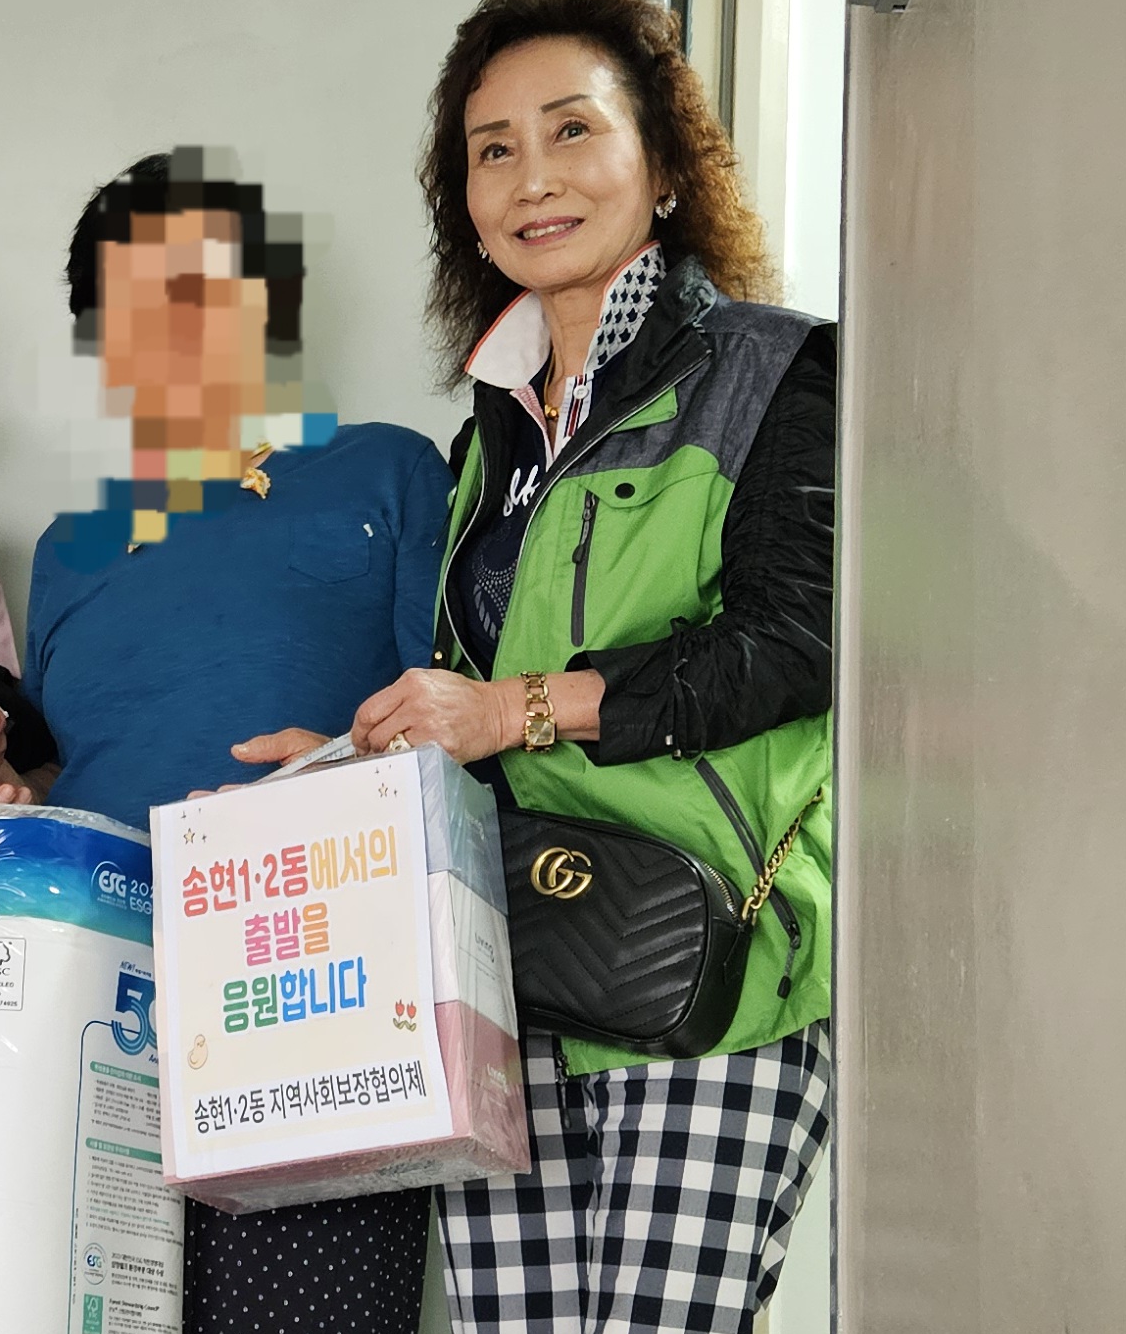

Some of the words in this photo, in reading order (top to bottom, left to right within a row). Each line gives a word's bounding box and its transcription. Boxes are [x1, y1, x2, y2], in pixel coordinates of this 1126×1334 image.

[98, 870, 127, 898] ESG
[183, 826, 398, 918] 송현1·2동에서의
[244, 901, 330, 967] 출발을
[223, 955, 367, 1033] 응원합니다
[194, 1089, 265, 1134] 송현1·2동
[269, 1060, 427, 1119] 지역사회보장협의체
